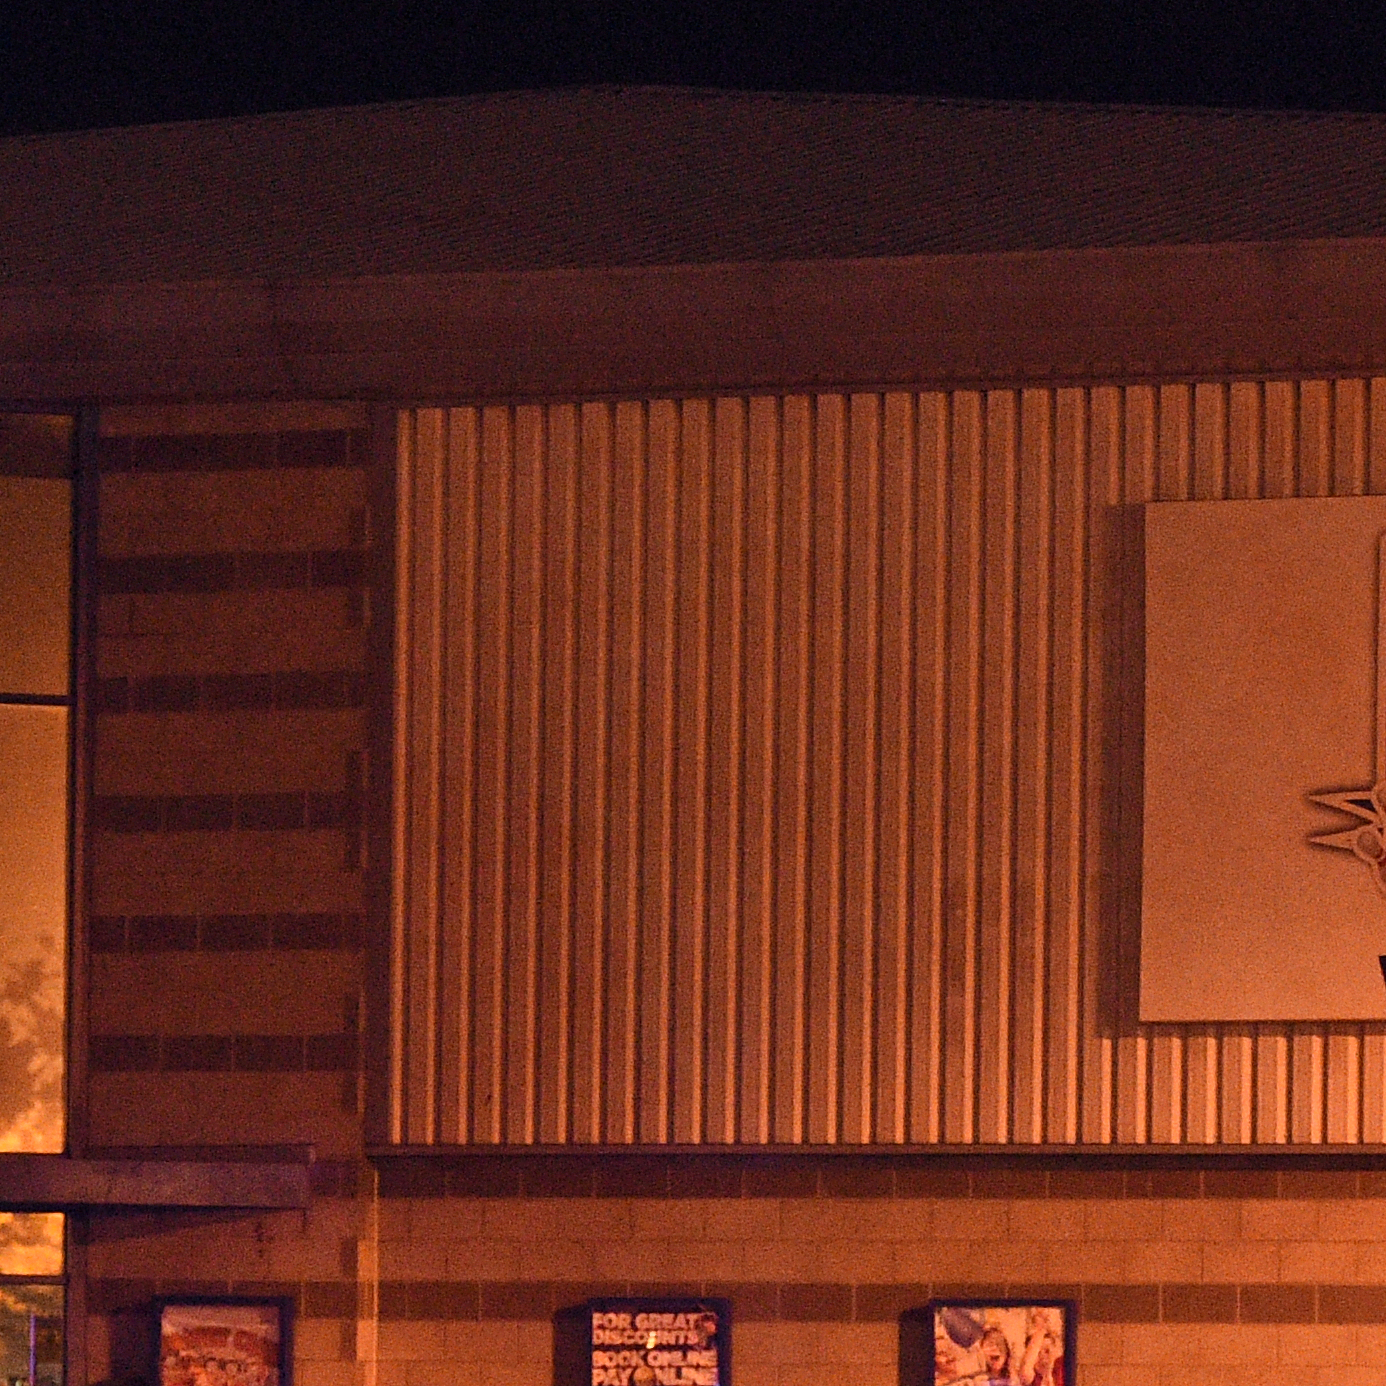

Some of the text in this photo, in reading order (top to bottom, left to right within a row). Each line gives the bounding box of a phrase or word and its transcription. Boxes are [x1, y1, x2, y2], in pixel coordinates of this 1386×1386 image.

[592, 1313, 697, 1330] FOR GREAT
[592, 1350, 645, 1367] BOOK
[592, 1368, 633, 1386] PAY
